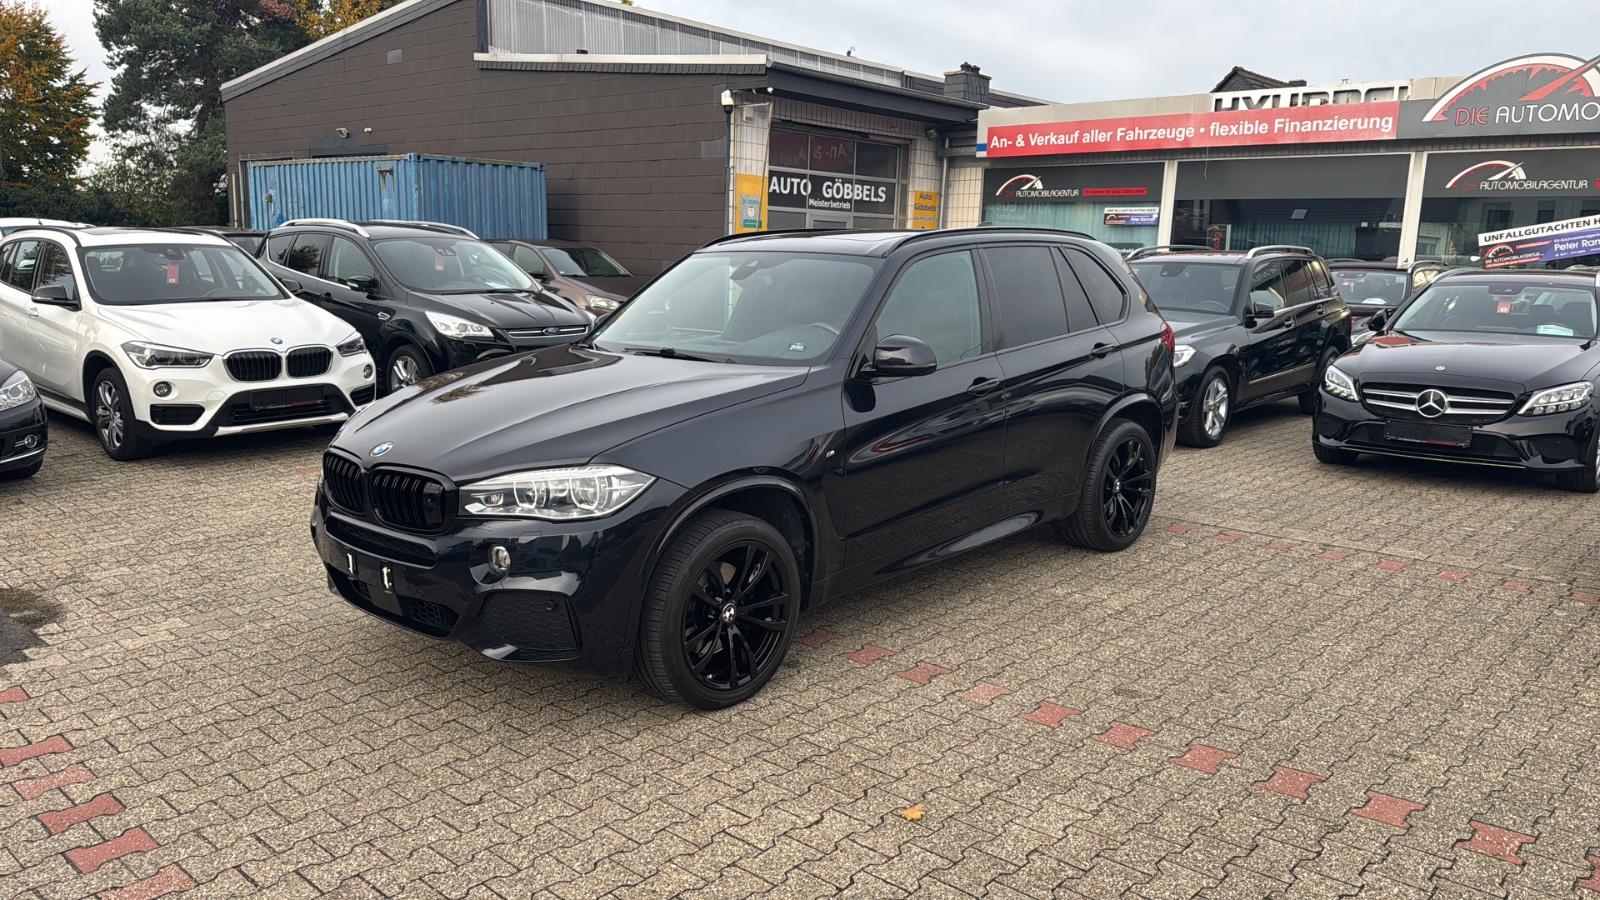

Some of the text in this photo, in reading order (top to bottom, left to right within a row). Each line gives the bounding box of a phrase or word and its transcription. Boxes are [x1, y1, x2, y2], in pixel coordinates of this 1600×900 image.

[1455, 102, 1600, 126] DIE AUTOMO
[990, 116, 1393, 149] An- & Verkauf aller Fahrzeuge flexible Finanzierung
[768, 176, 887, 203] AUTO GÖBBELS
[1480, 180, 1588, 191] AUTOMOBILAGENTUR
[808, 198, 851, 209] Meisterbetrieb
[1484, 219, 1591, 243] UNFALLGUTACHTEN
[1554, 242, 1579, 252] Peter
